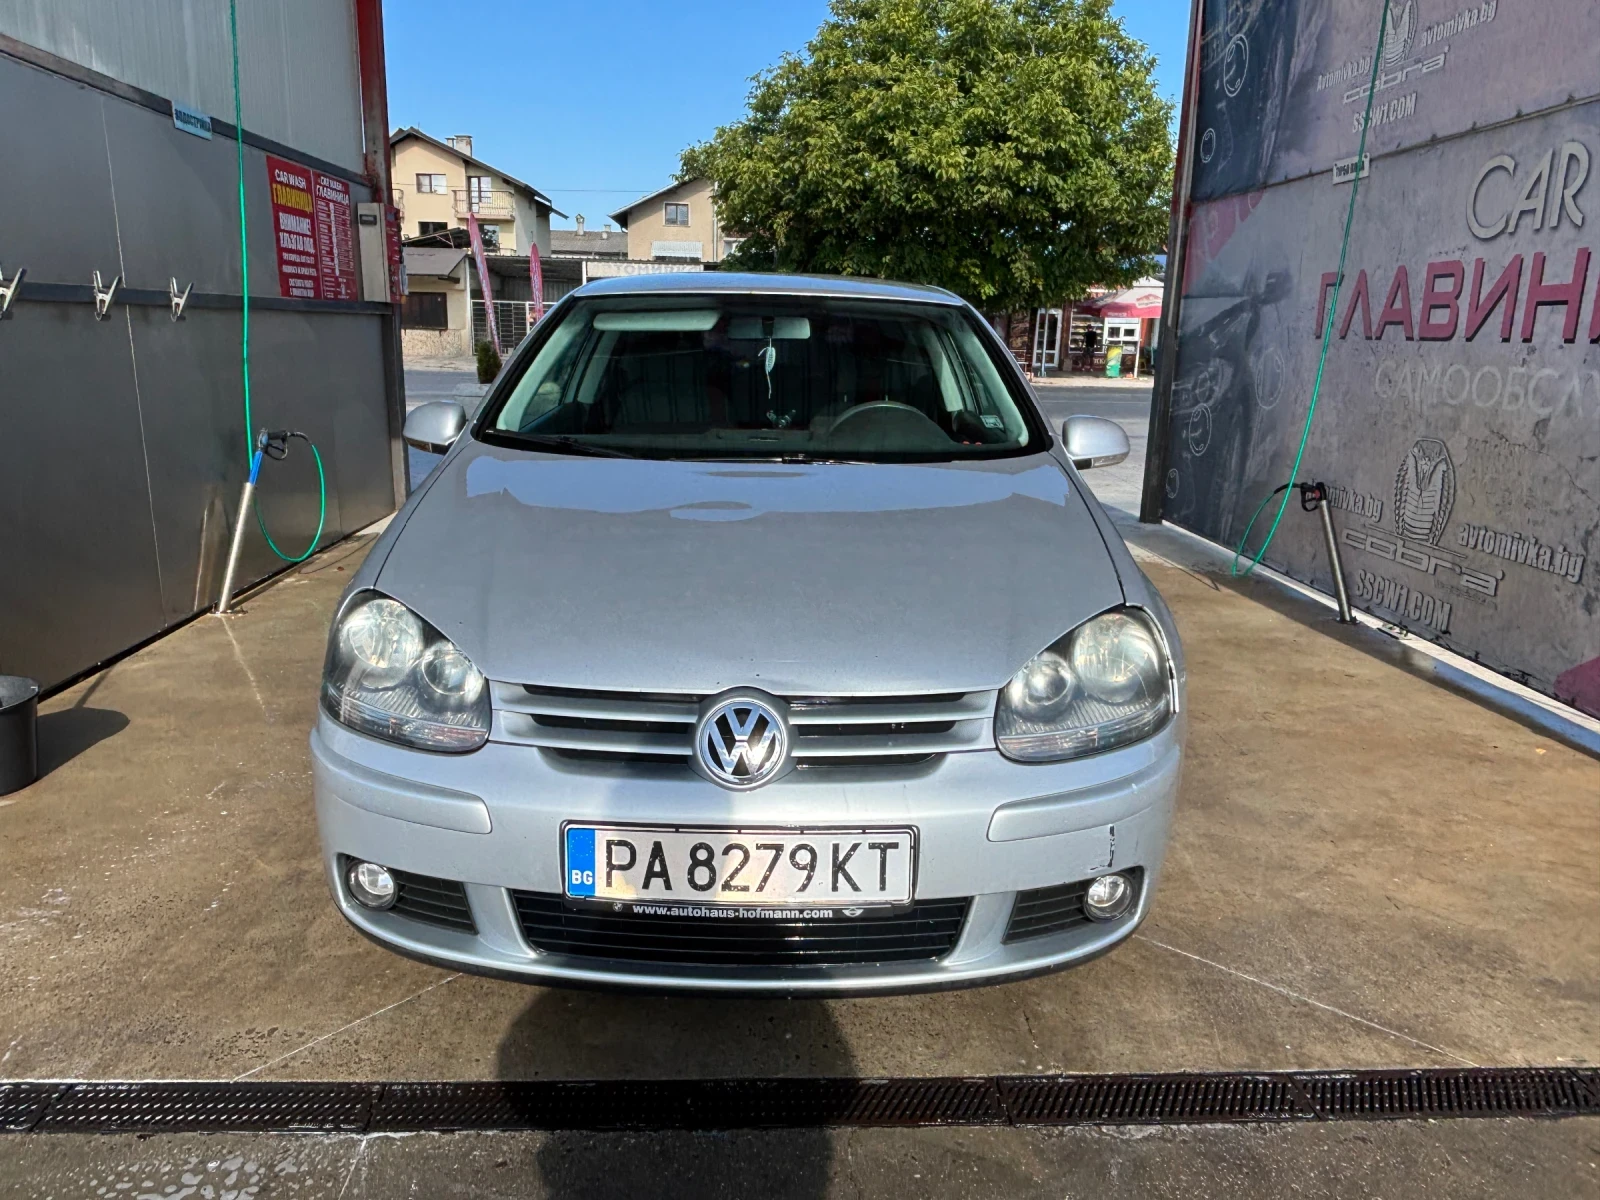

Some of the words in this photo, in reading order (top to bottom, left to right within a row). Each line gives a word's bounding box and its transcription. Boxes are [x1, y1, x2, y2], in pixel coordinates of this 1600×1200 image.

[1421, 0, 1499, 48] avtomivka.bg
[274, 168, 288, 184] CAR
[288, 173, 307, 190] WASH
[1465, 140, 1592, 241] CAR
[1315, 246, 1600, 344] ГЛАВИН
[1341, 528, 1500, 597] cobra
[1457, 523, 1586, 584] avtomivka.bg
[1355, 568, 1452, 631] SSCW1.COM
[571, 869, 593, 886] BG
[686, 841, 818, 893] 8279
[632, 904, 833, 919] www.autohaus-hofmann.com
